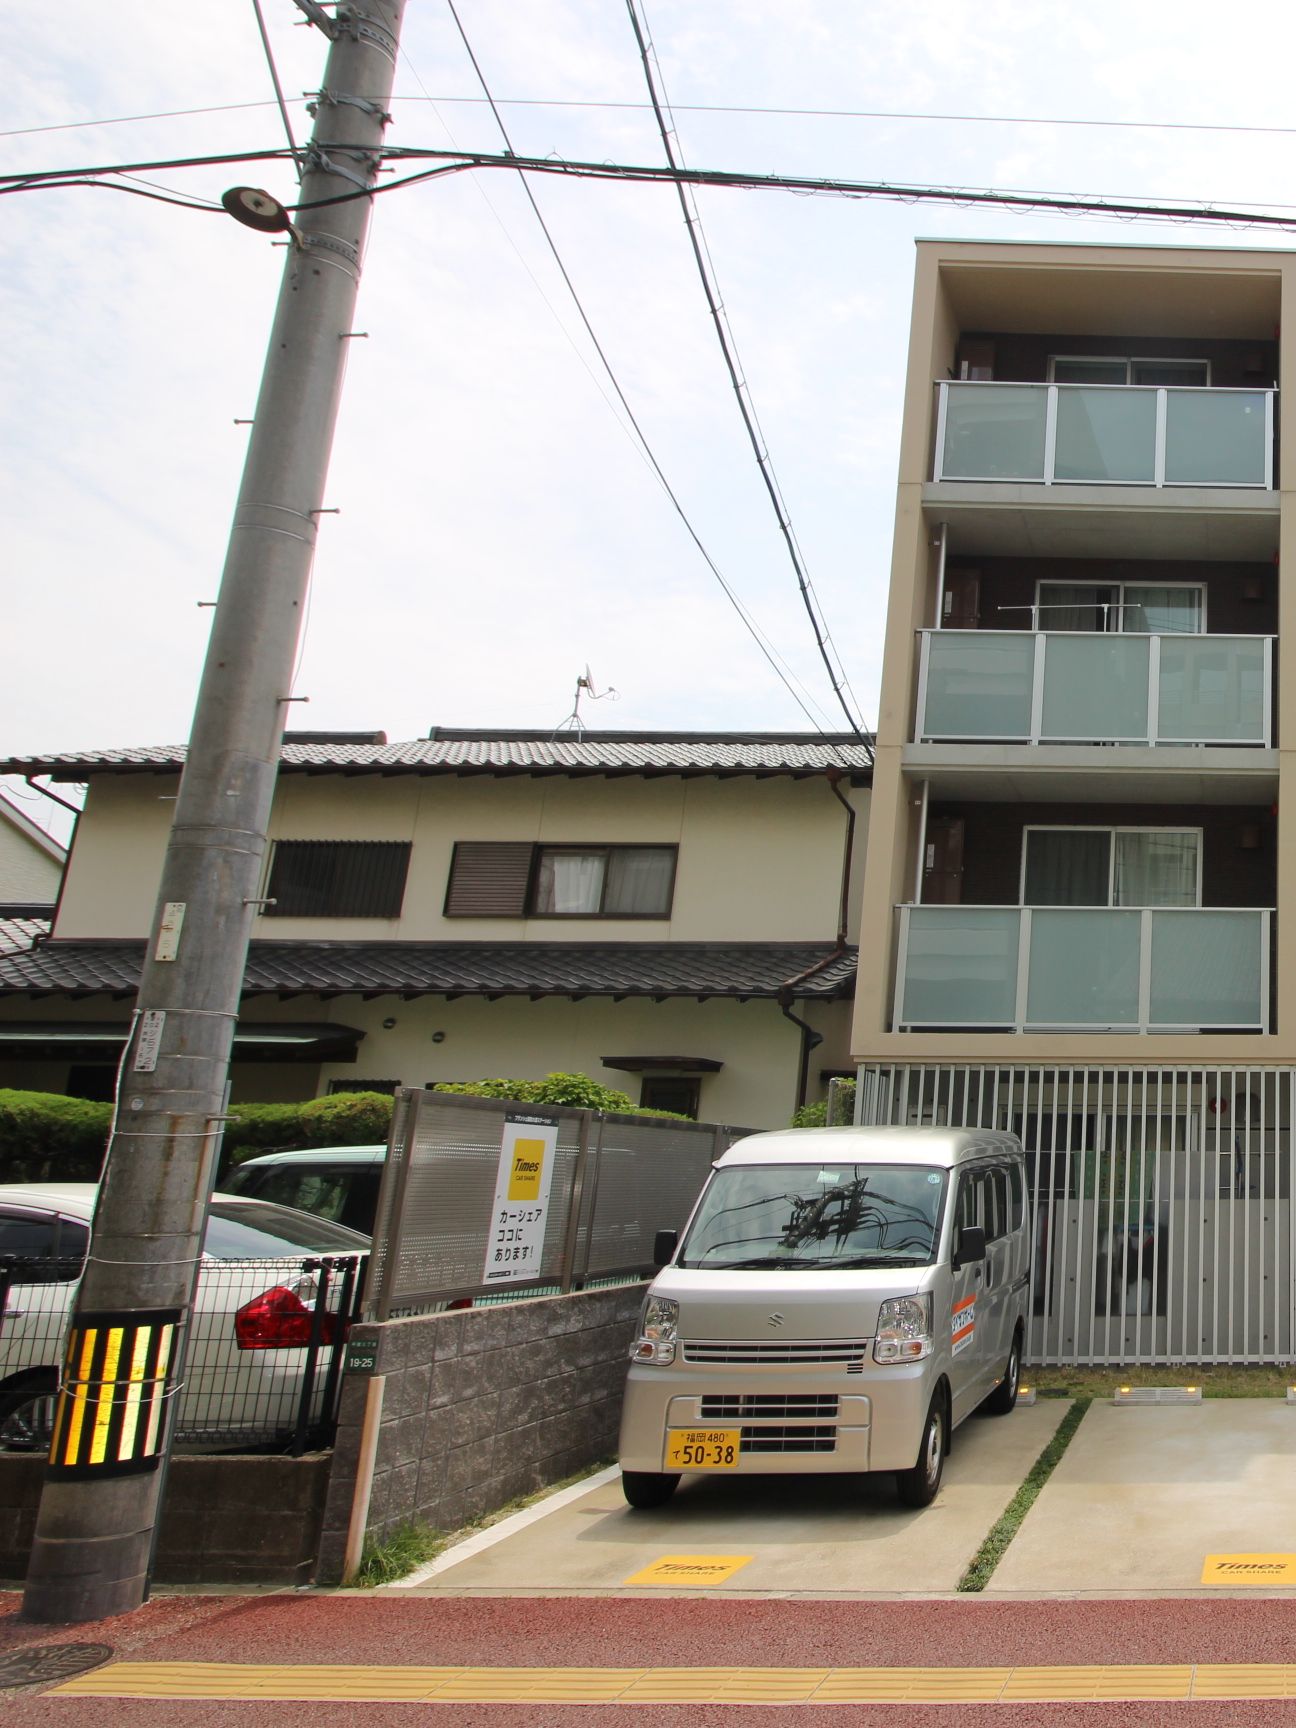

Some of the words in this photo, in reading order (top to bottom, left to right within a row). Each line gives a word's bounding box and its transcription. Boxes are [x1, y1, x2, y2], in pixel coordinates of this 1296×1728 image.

[515, 1158, 540, 1172] Times
[499, 1208, 543, 1224] カーシェア
[497, 1228, 523, 1242] ココに
[494, 1245, 534, 1262] あります!
[350, 1357, 374, 1368] 19-25
[686, 1432, 706, 1443] 福岡
[707, 1432, 725, 1443] 480
[672, 1450, 681, 1460] て
[682, 1445, 735, 1465] 50-38
[654, 1563, 732, 1571] Times
[1215, 1562, 1288, 1570] Times
